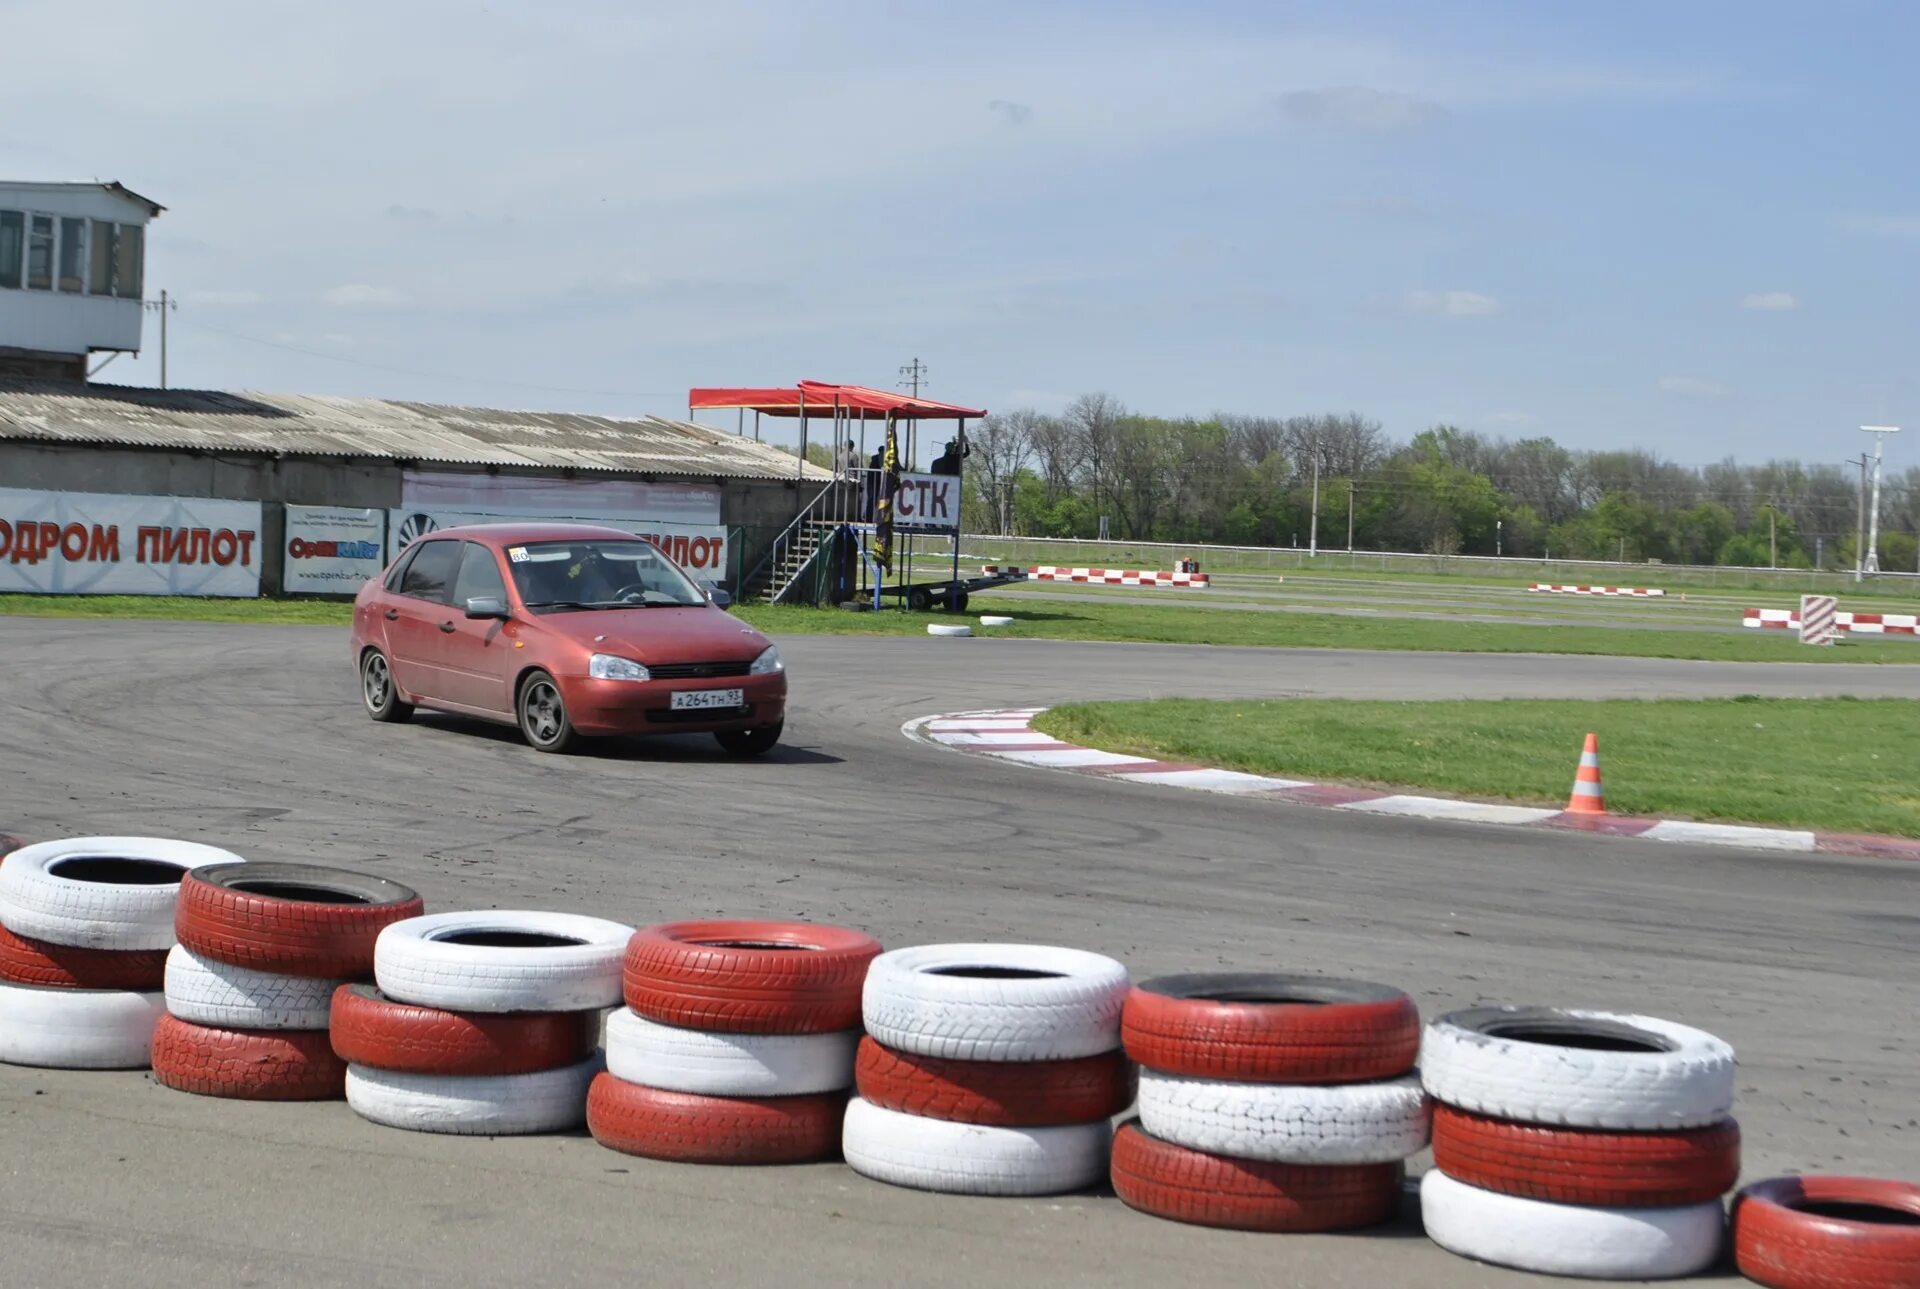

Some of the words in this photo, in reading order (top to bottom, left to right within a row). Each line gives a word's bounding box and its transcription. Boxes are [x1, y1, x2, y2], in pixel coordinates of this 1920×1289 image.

[899, 479, 949, 518] СТК
[137, 526, 256, 566] ПИЛОТ
[512, 552, 528, 561] 80
